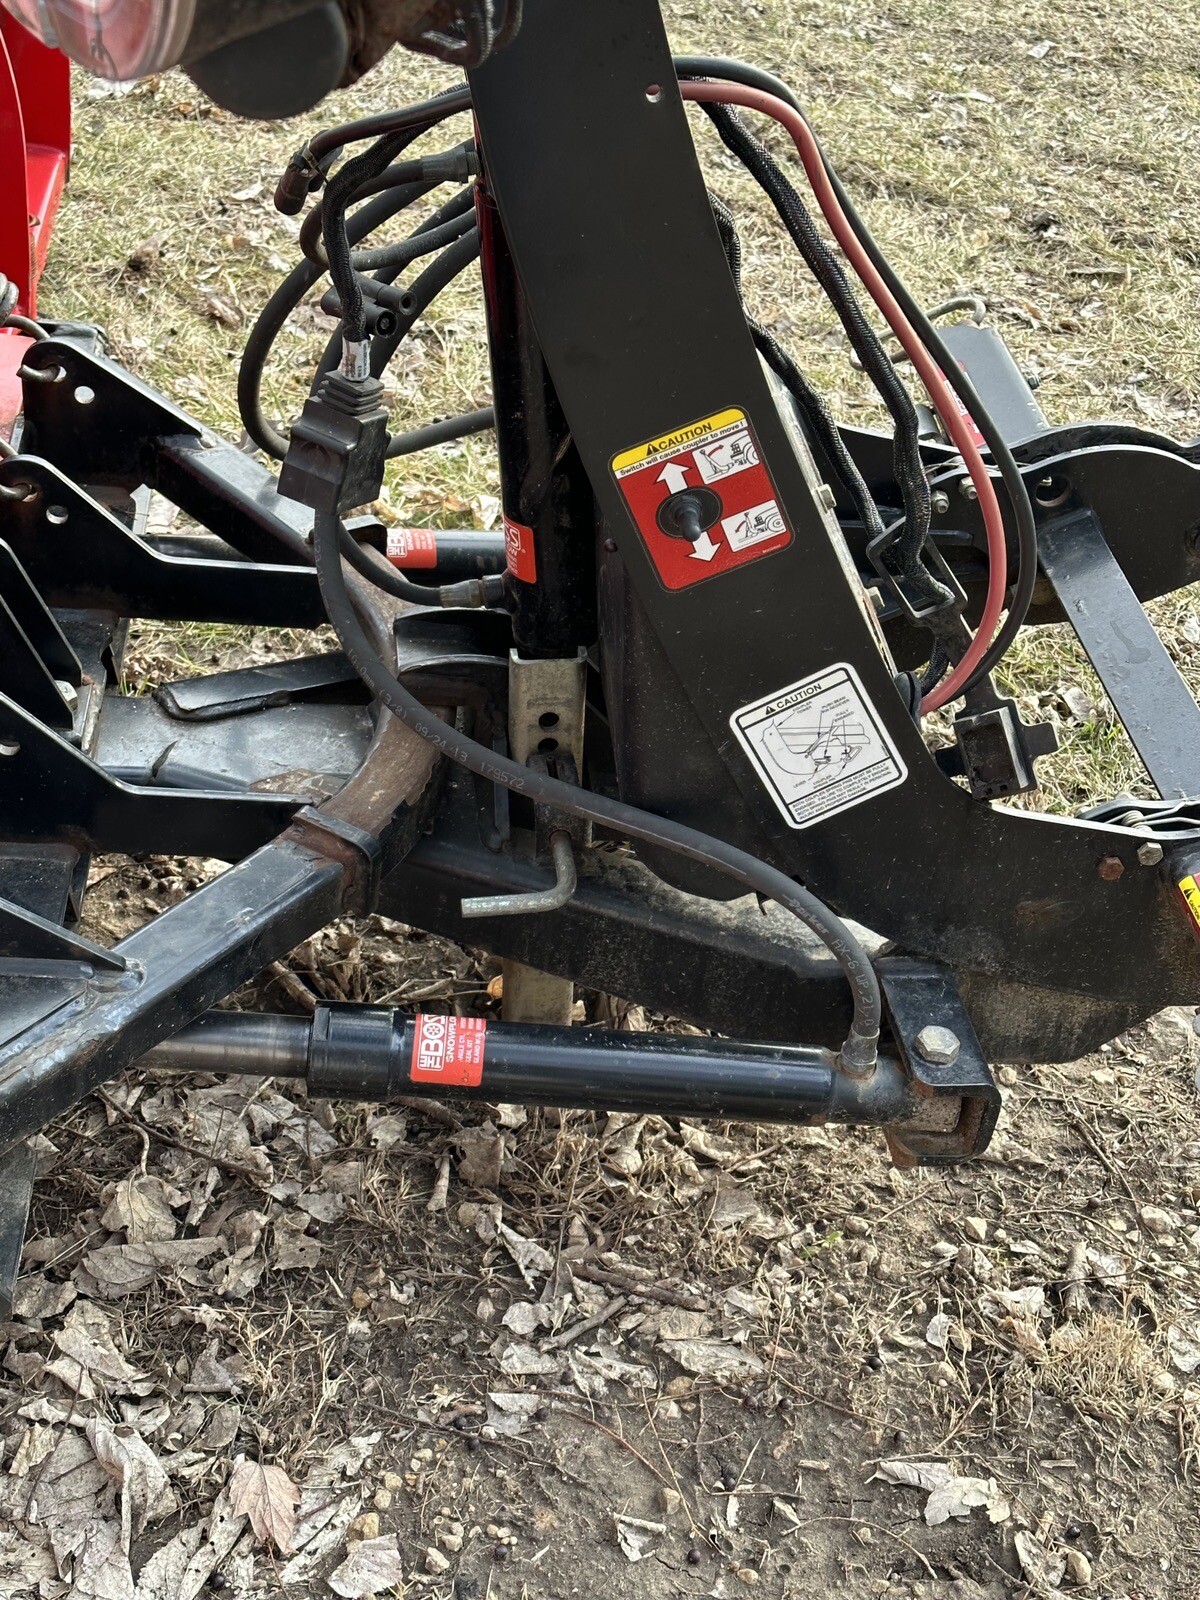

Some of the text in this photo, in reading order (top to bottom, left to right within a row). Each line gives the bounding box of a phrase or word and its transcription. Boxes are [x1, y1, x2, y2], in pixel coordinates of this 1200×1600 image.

[620, 462, 644, 475] Switch
[660, 449, 680, 460] cause
[682, 436, 709, 451] coupler
[719, 424, 739, 434] move
[658, 422, 713, 450] CAUTION
[388, 546, 405, 555] THE
[776, 683, 822, 709] CAUTION
[378, 689, 408, 719] (3/8)
[479, 762, 525, 790] 179572
[788, 898, 831, 934] Parker
[420, 1013, 445, 1056] BOS
[419, 1054, 442, 1068] THE
